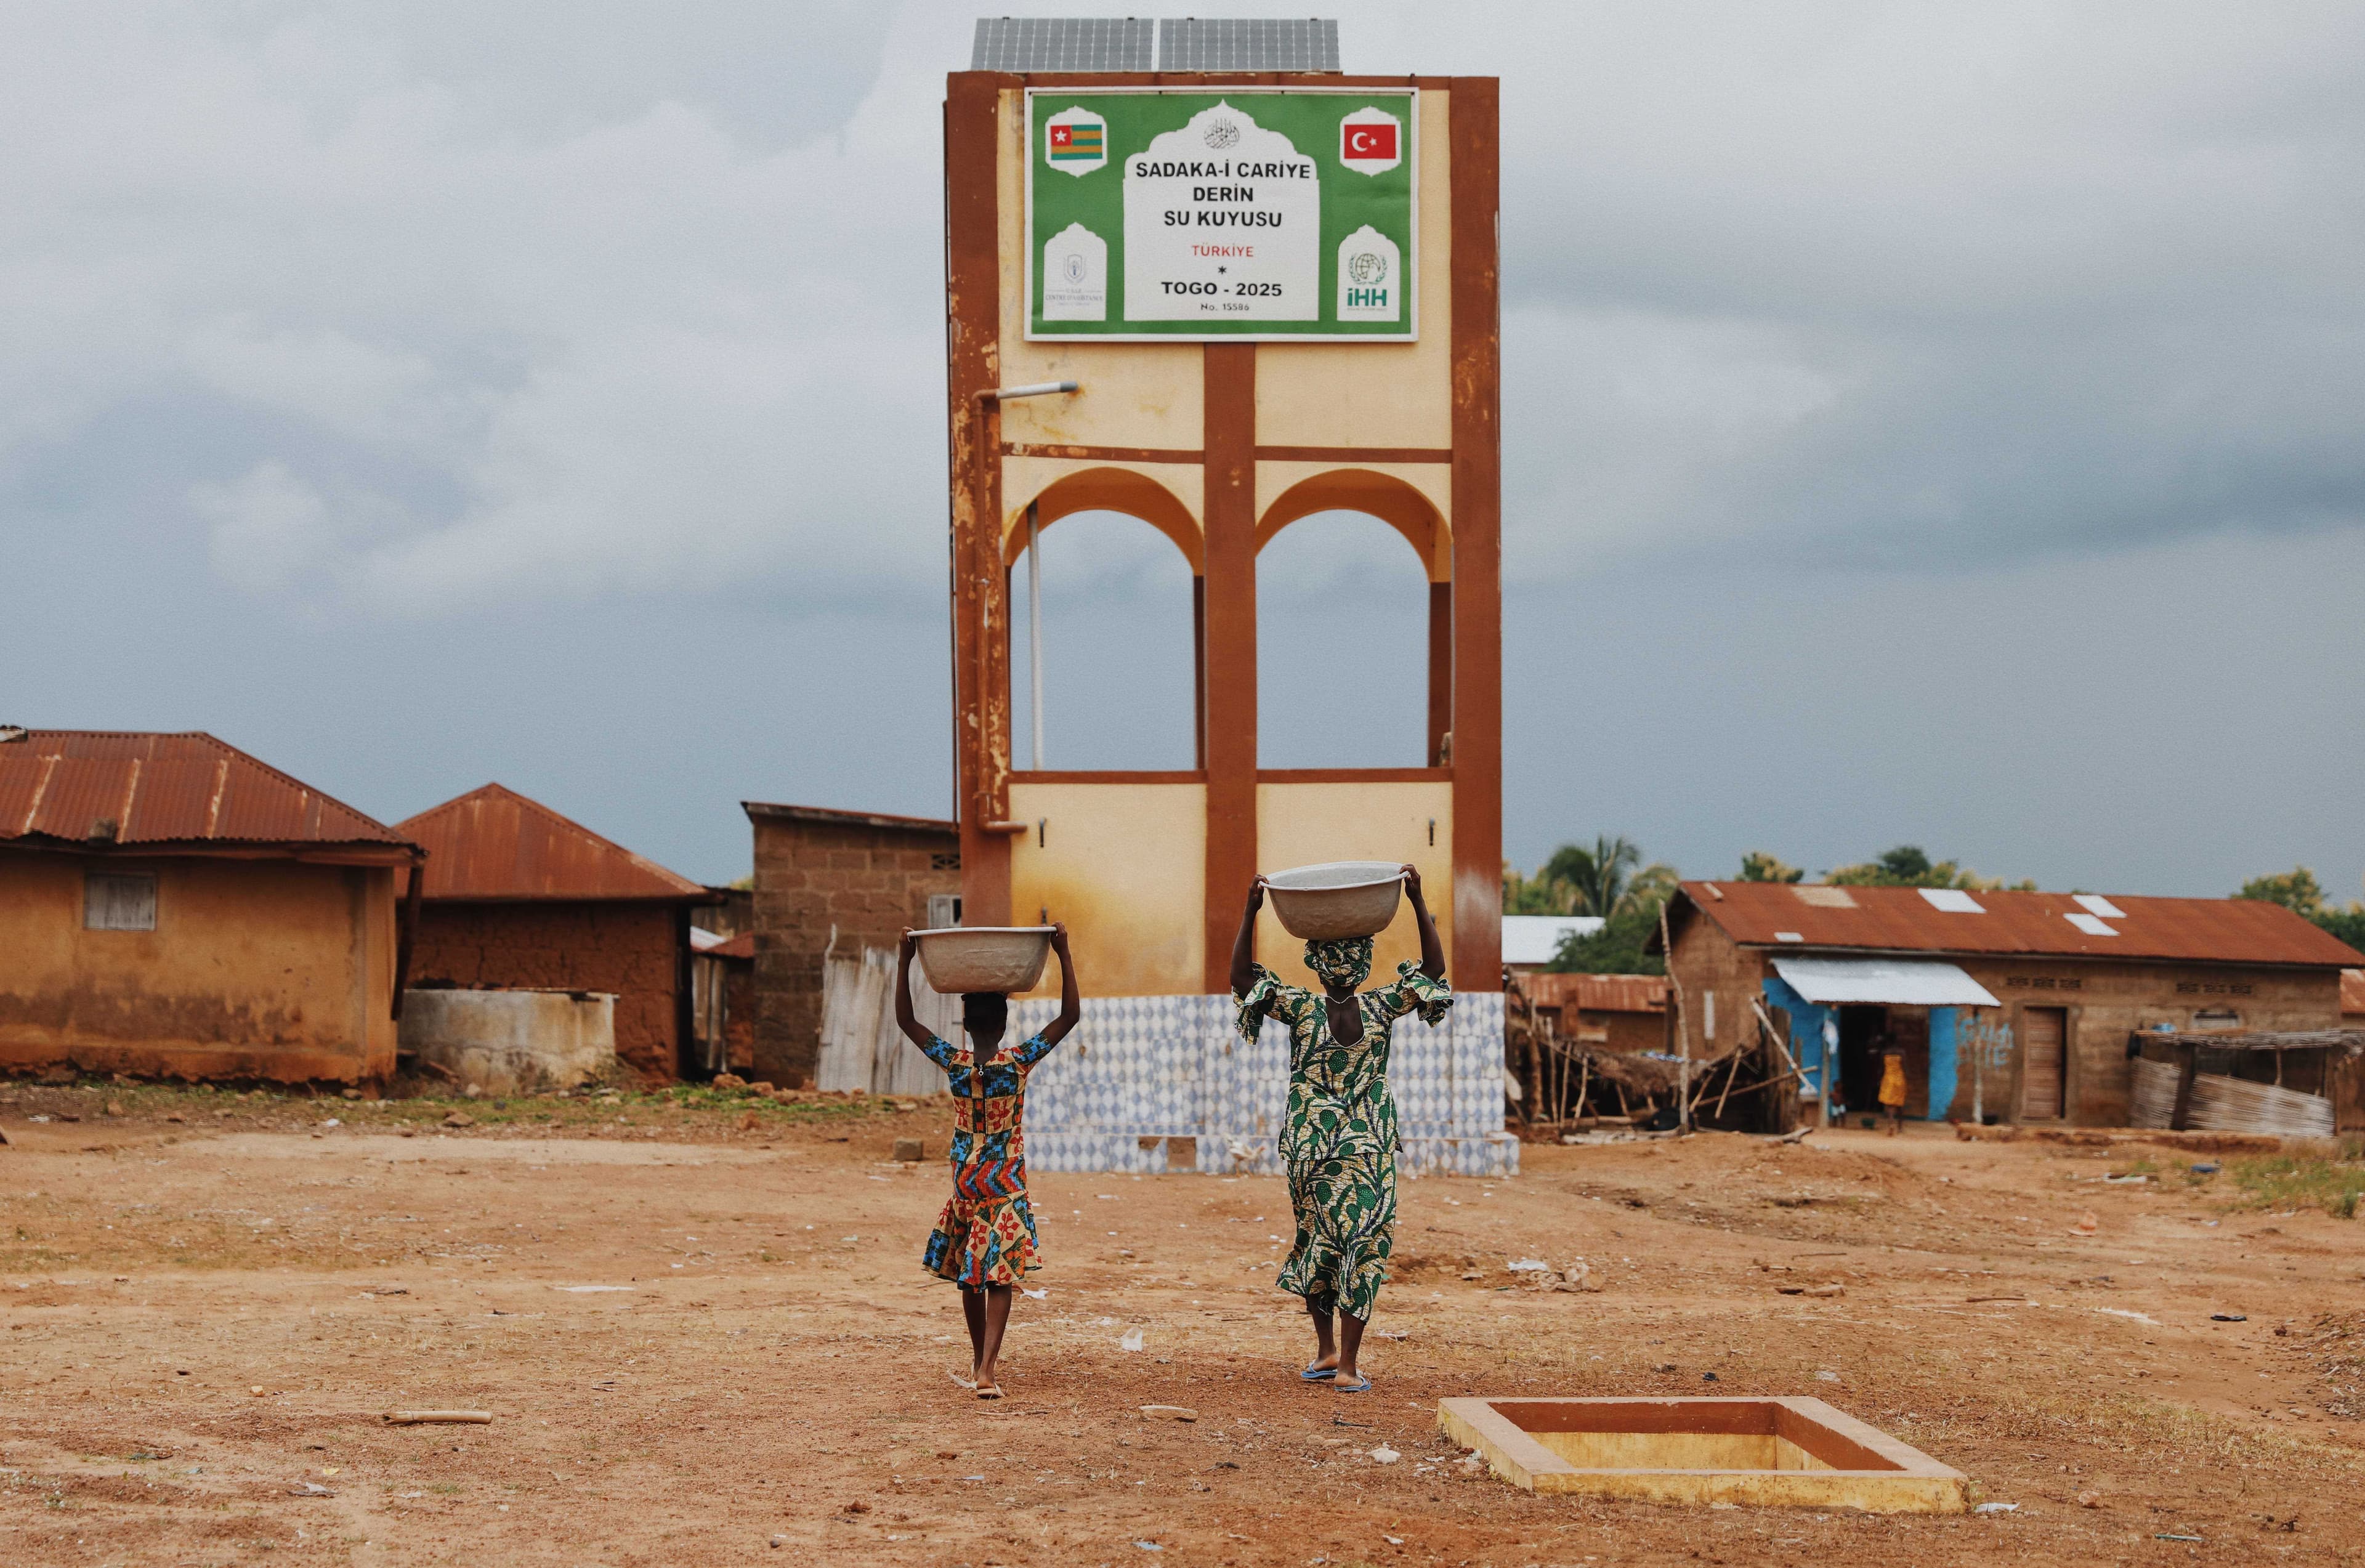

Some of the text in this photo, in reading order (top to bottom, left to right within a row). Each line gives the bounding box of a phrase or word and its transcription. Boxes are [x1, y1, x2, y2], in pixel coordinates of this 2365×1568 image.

[1136, 159, 1311, 179] SADAKA-İ CARİYE
[1193, 183, 1253, 202] DERİN
[1164, 210, 1282, 227] SU KUYUSU
[1192, 243, 1254, 257] TÜRKİYE
[1161, 281, 1218, 295] TOGO
[1235, 283, 1282, 296] 2025
[1200, 302, 1250, 311] No. 15586
